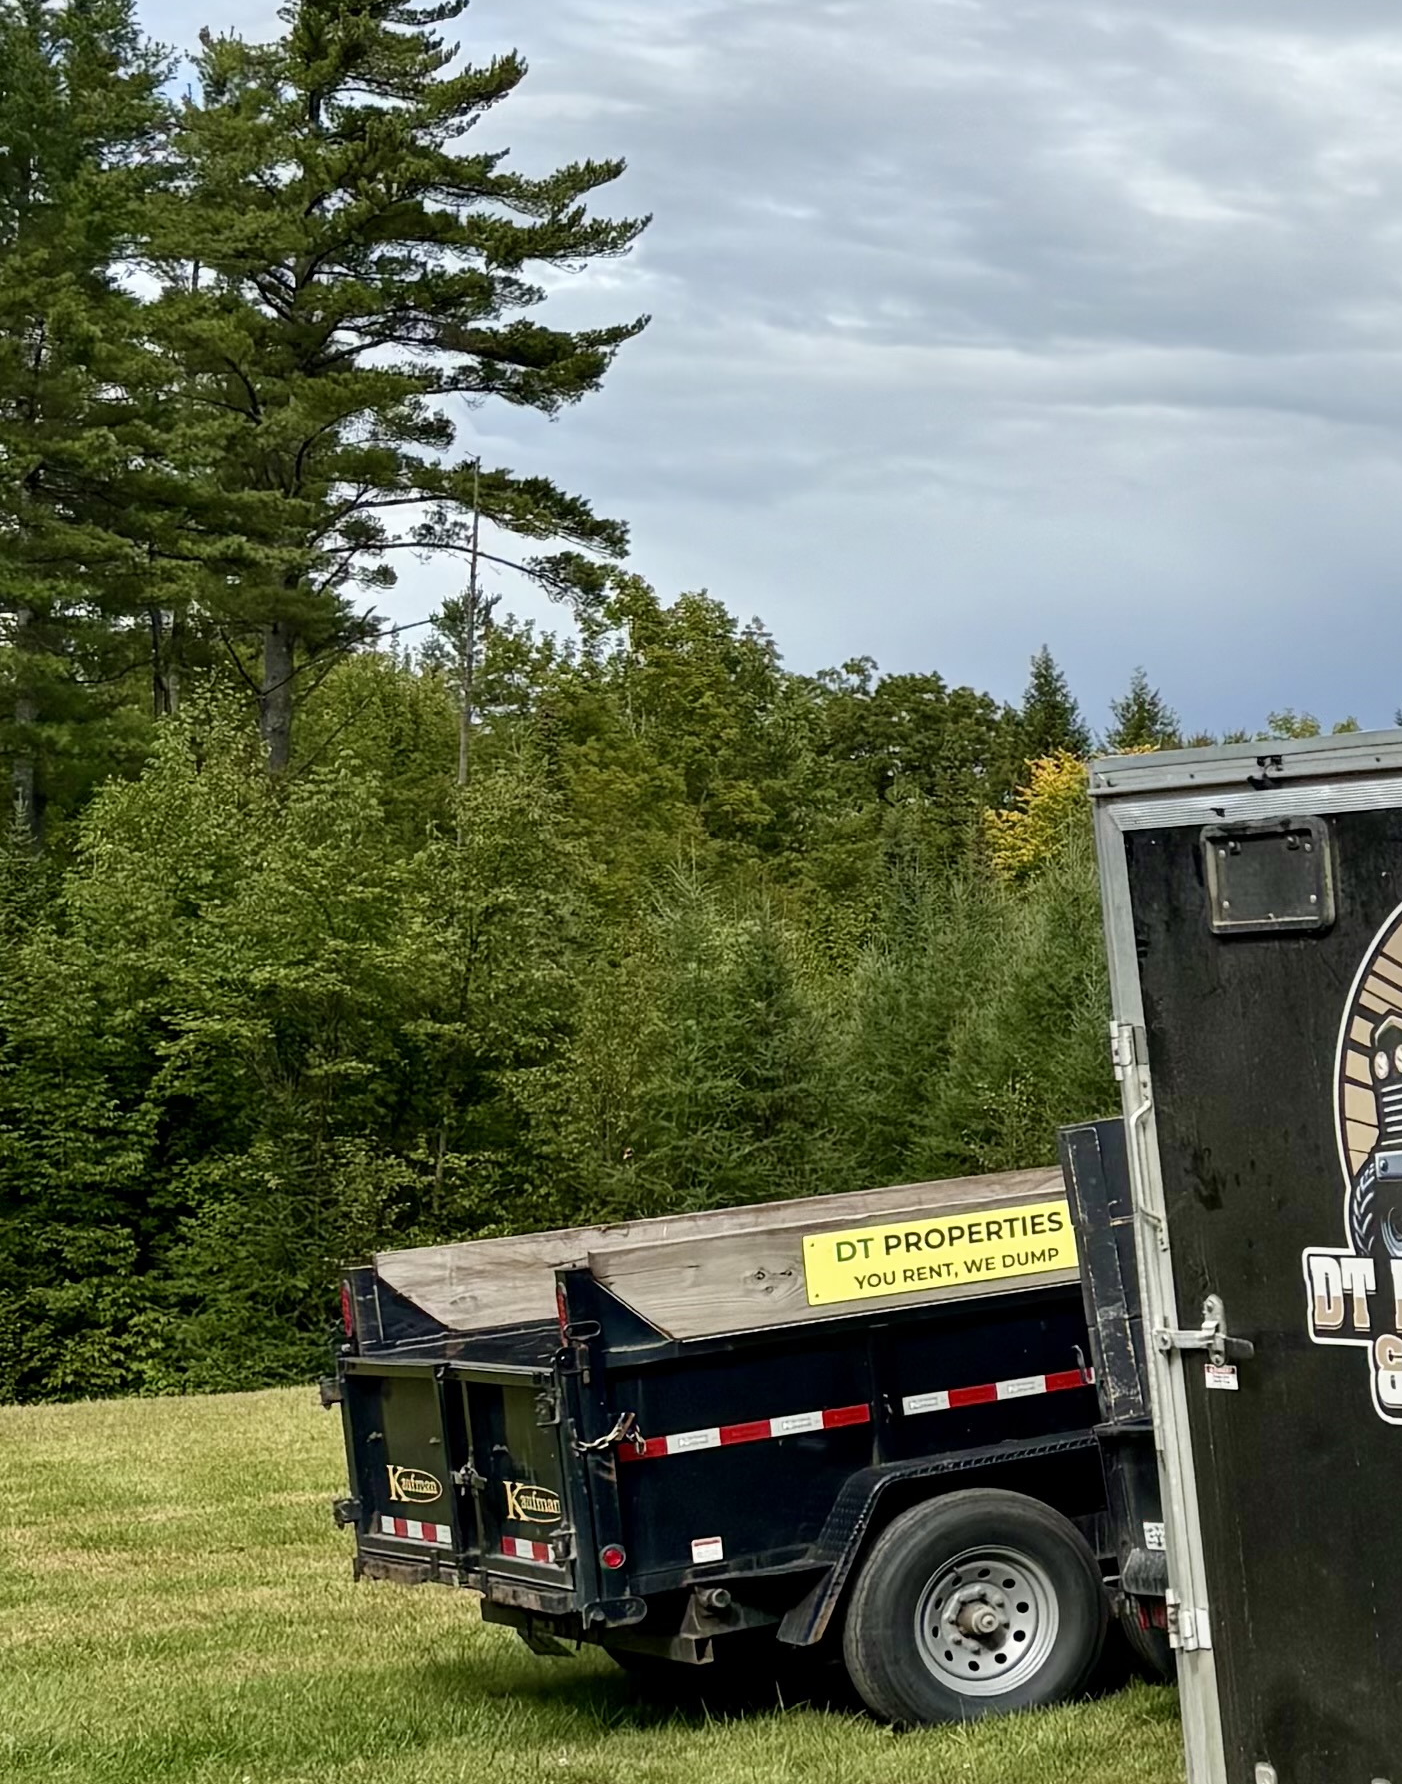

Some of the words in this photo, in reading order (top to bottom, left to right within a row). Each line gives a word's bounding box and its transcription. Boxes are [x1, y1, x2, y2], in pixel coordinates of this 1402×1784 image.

[835, 1237, 875, 1262] DT
[884, 1211, 1064, 1256] PROPERTIES
[854, 1270, 896, 1290] YOU
[903, 1262, 959, 1283] RENT,
[963, 1256, 997, 1274] WE
[1002, 1247, 1060, 1269] DUMP
[1309, 1256, 1376, 1331] DT
[386, 1464, 438, 1503] Kaufman
[503, 1480, 562, 1522] Kaufman
